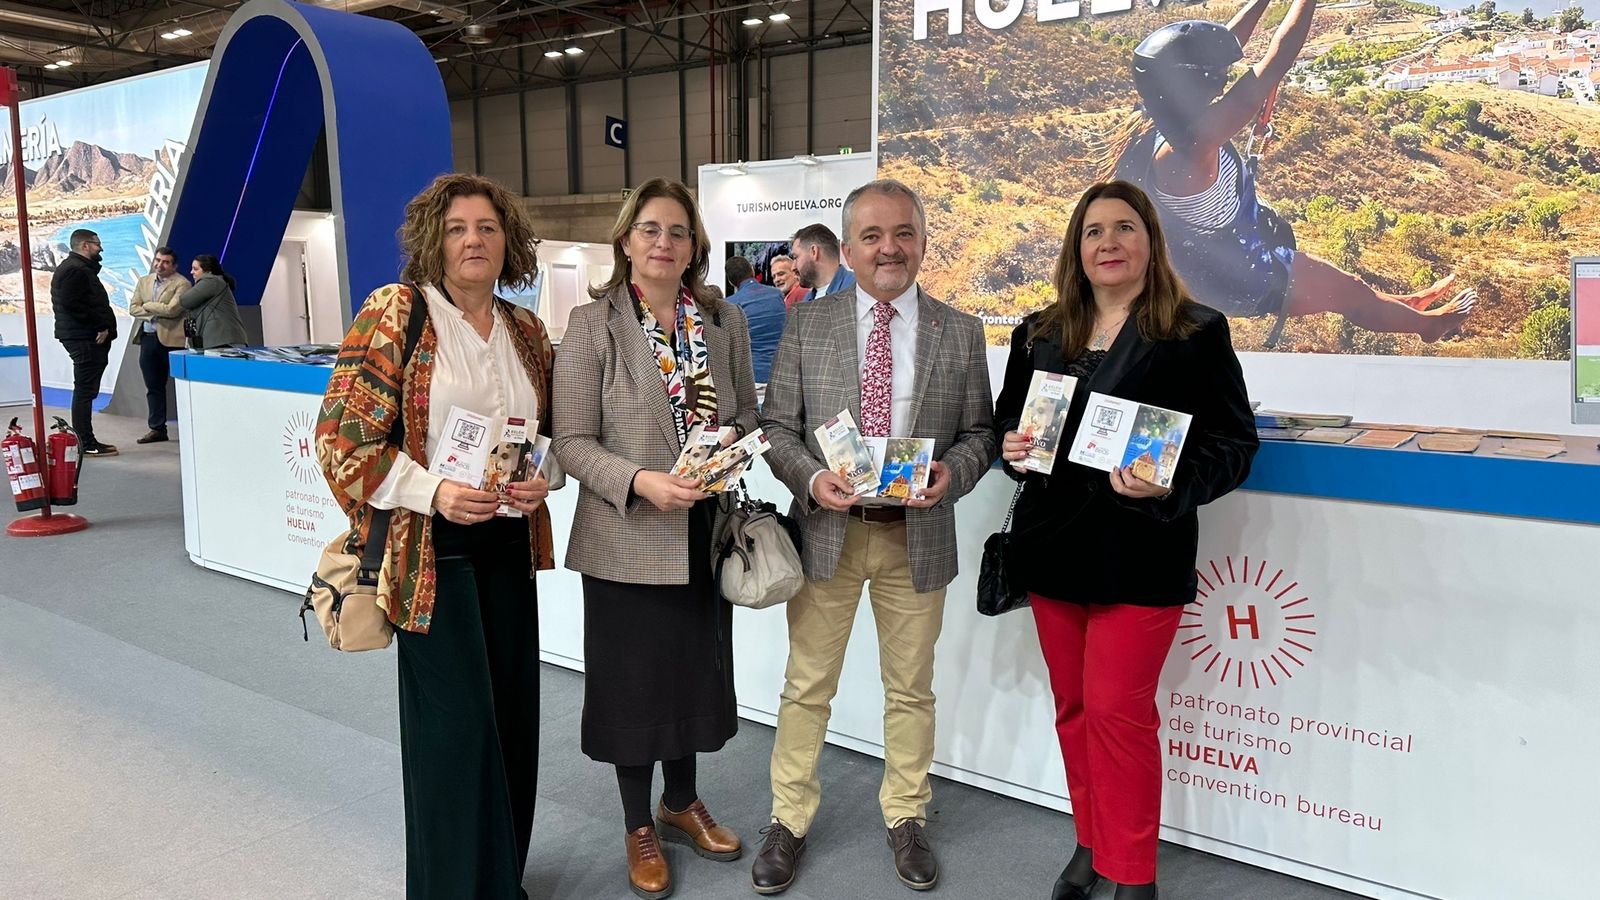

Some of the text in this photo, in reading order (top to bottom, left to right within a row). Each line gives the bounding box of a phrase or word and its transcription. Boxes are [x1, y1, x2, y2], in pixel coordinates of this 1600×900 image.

[610, 122, 623, 145] C
[737, 198, 842, 213] TURISMOHUELVA.ORG
[299, 437, 310, 458] H
[286, 489, 320, 504] patronato
[286, 504, 325, 520] de turismo
[287, 517, 316, 532] HUELVA
[287, 532, 325, 549] convention
[1226, 604, 1260, 640] H
[1170, 691, 1413, 753] patronato provincial
[1168, 714, 1292, 756] de turismo
[1168, 739, 1259, 775] HUELVA
[1166, 767, 1382, 832] convention bureau
